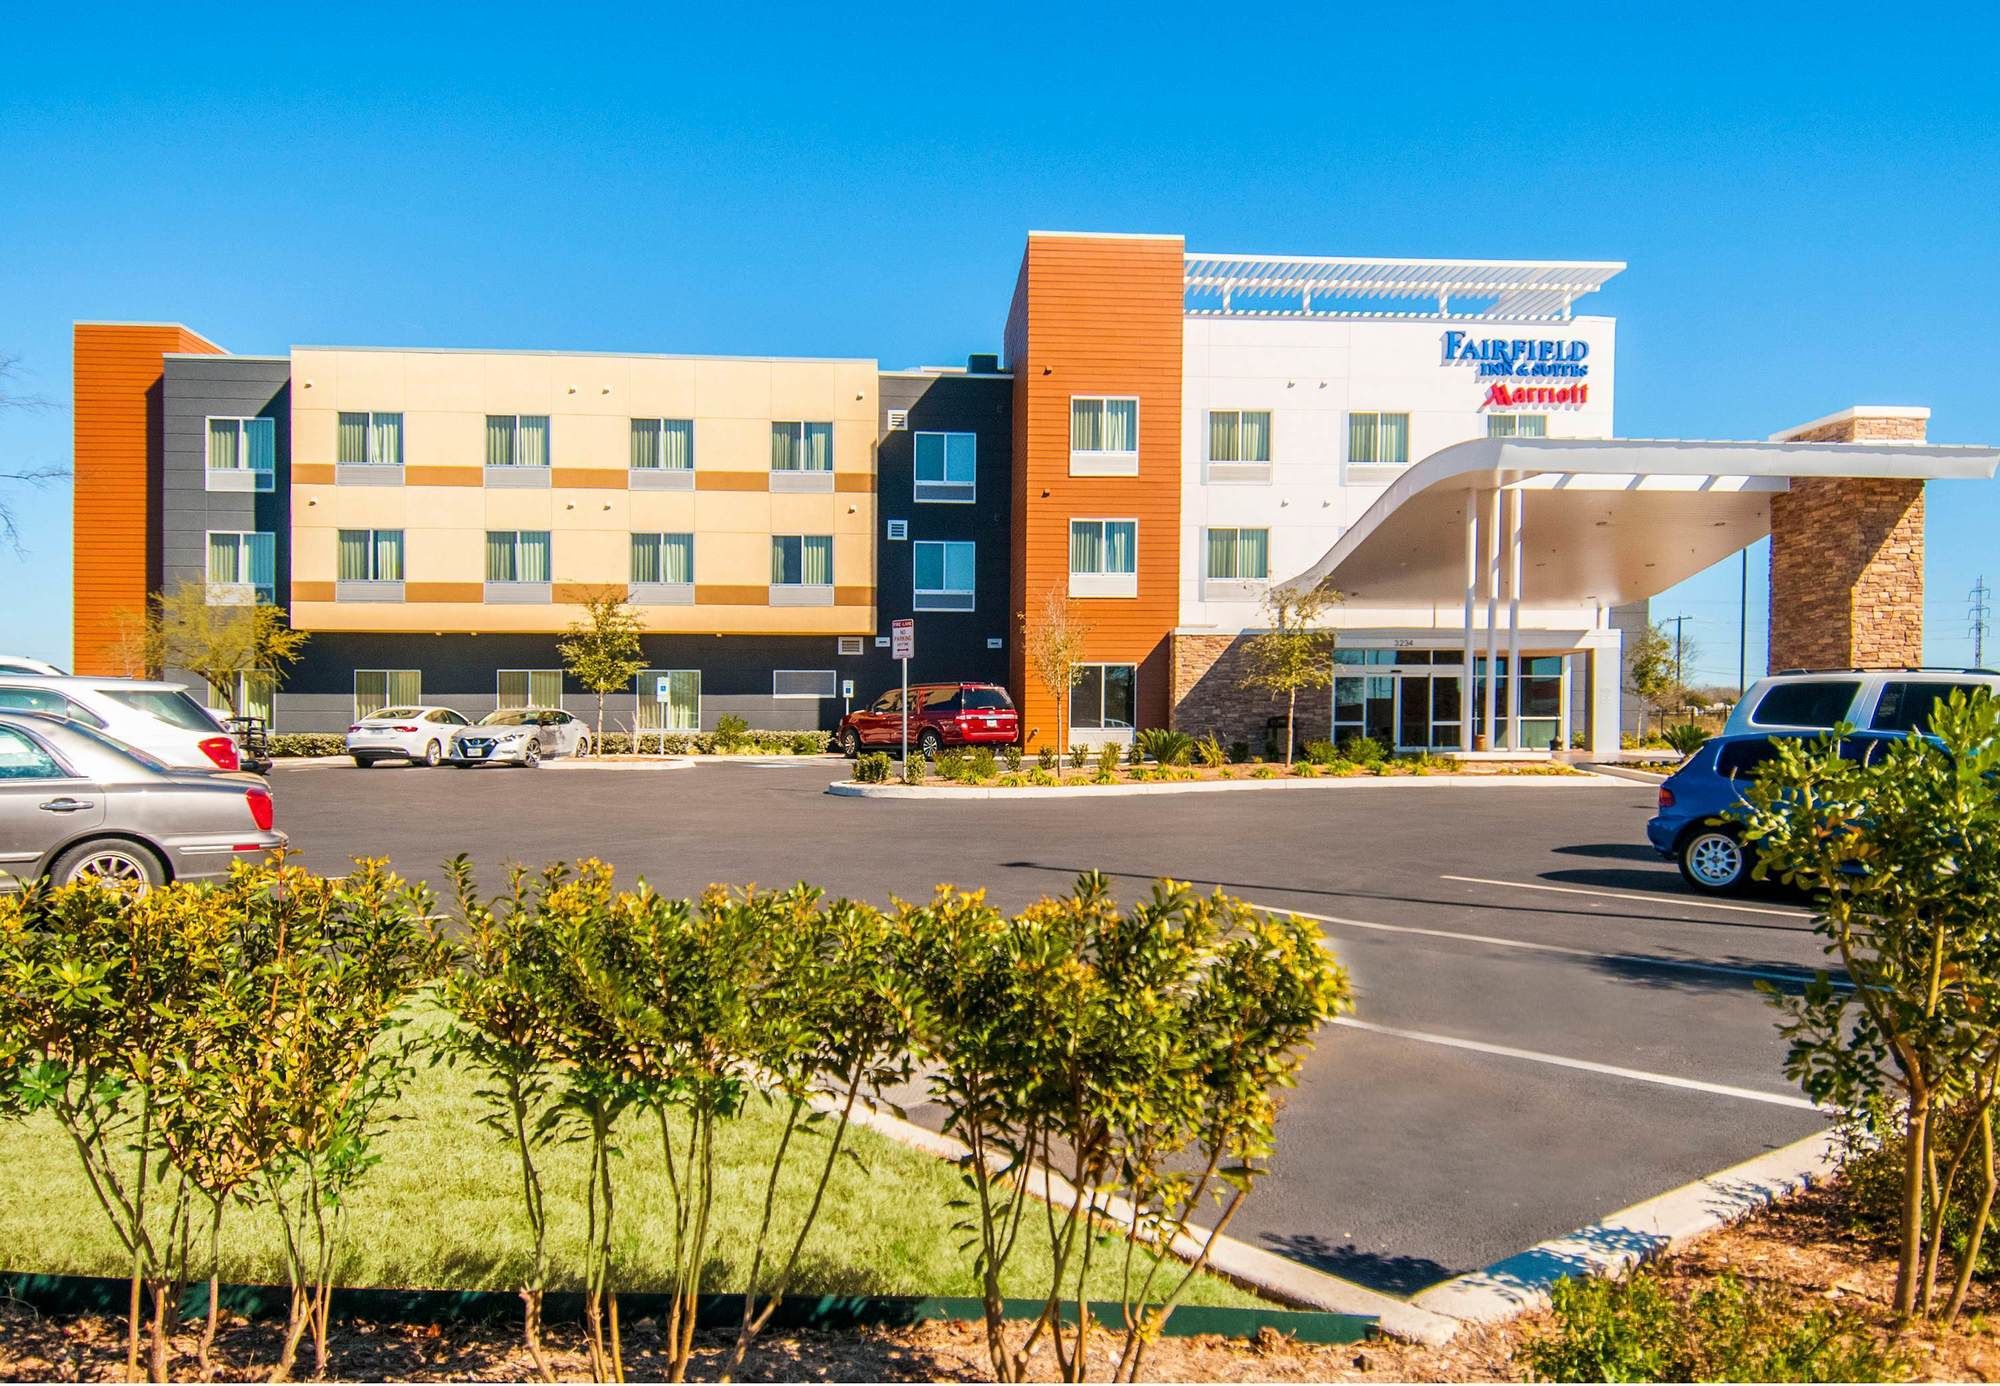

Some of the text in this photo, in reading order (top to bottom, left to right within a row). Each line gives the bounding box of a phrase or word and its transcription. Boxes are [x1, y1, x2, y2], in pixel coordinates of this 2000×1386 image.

[1445, 331, 1589, 361] FAIRFIELD
[1480, 362, 1588, 378] INN & SUITES
[1482, 383, 1588, 407] Marriott
